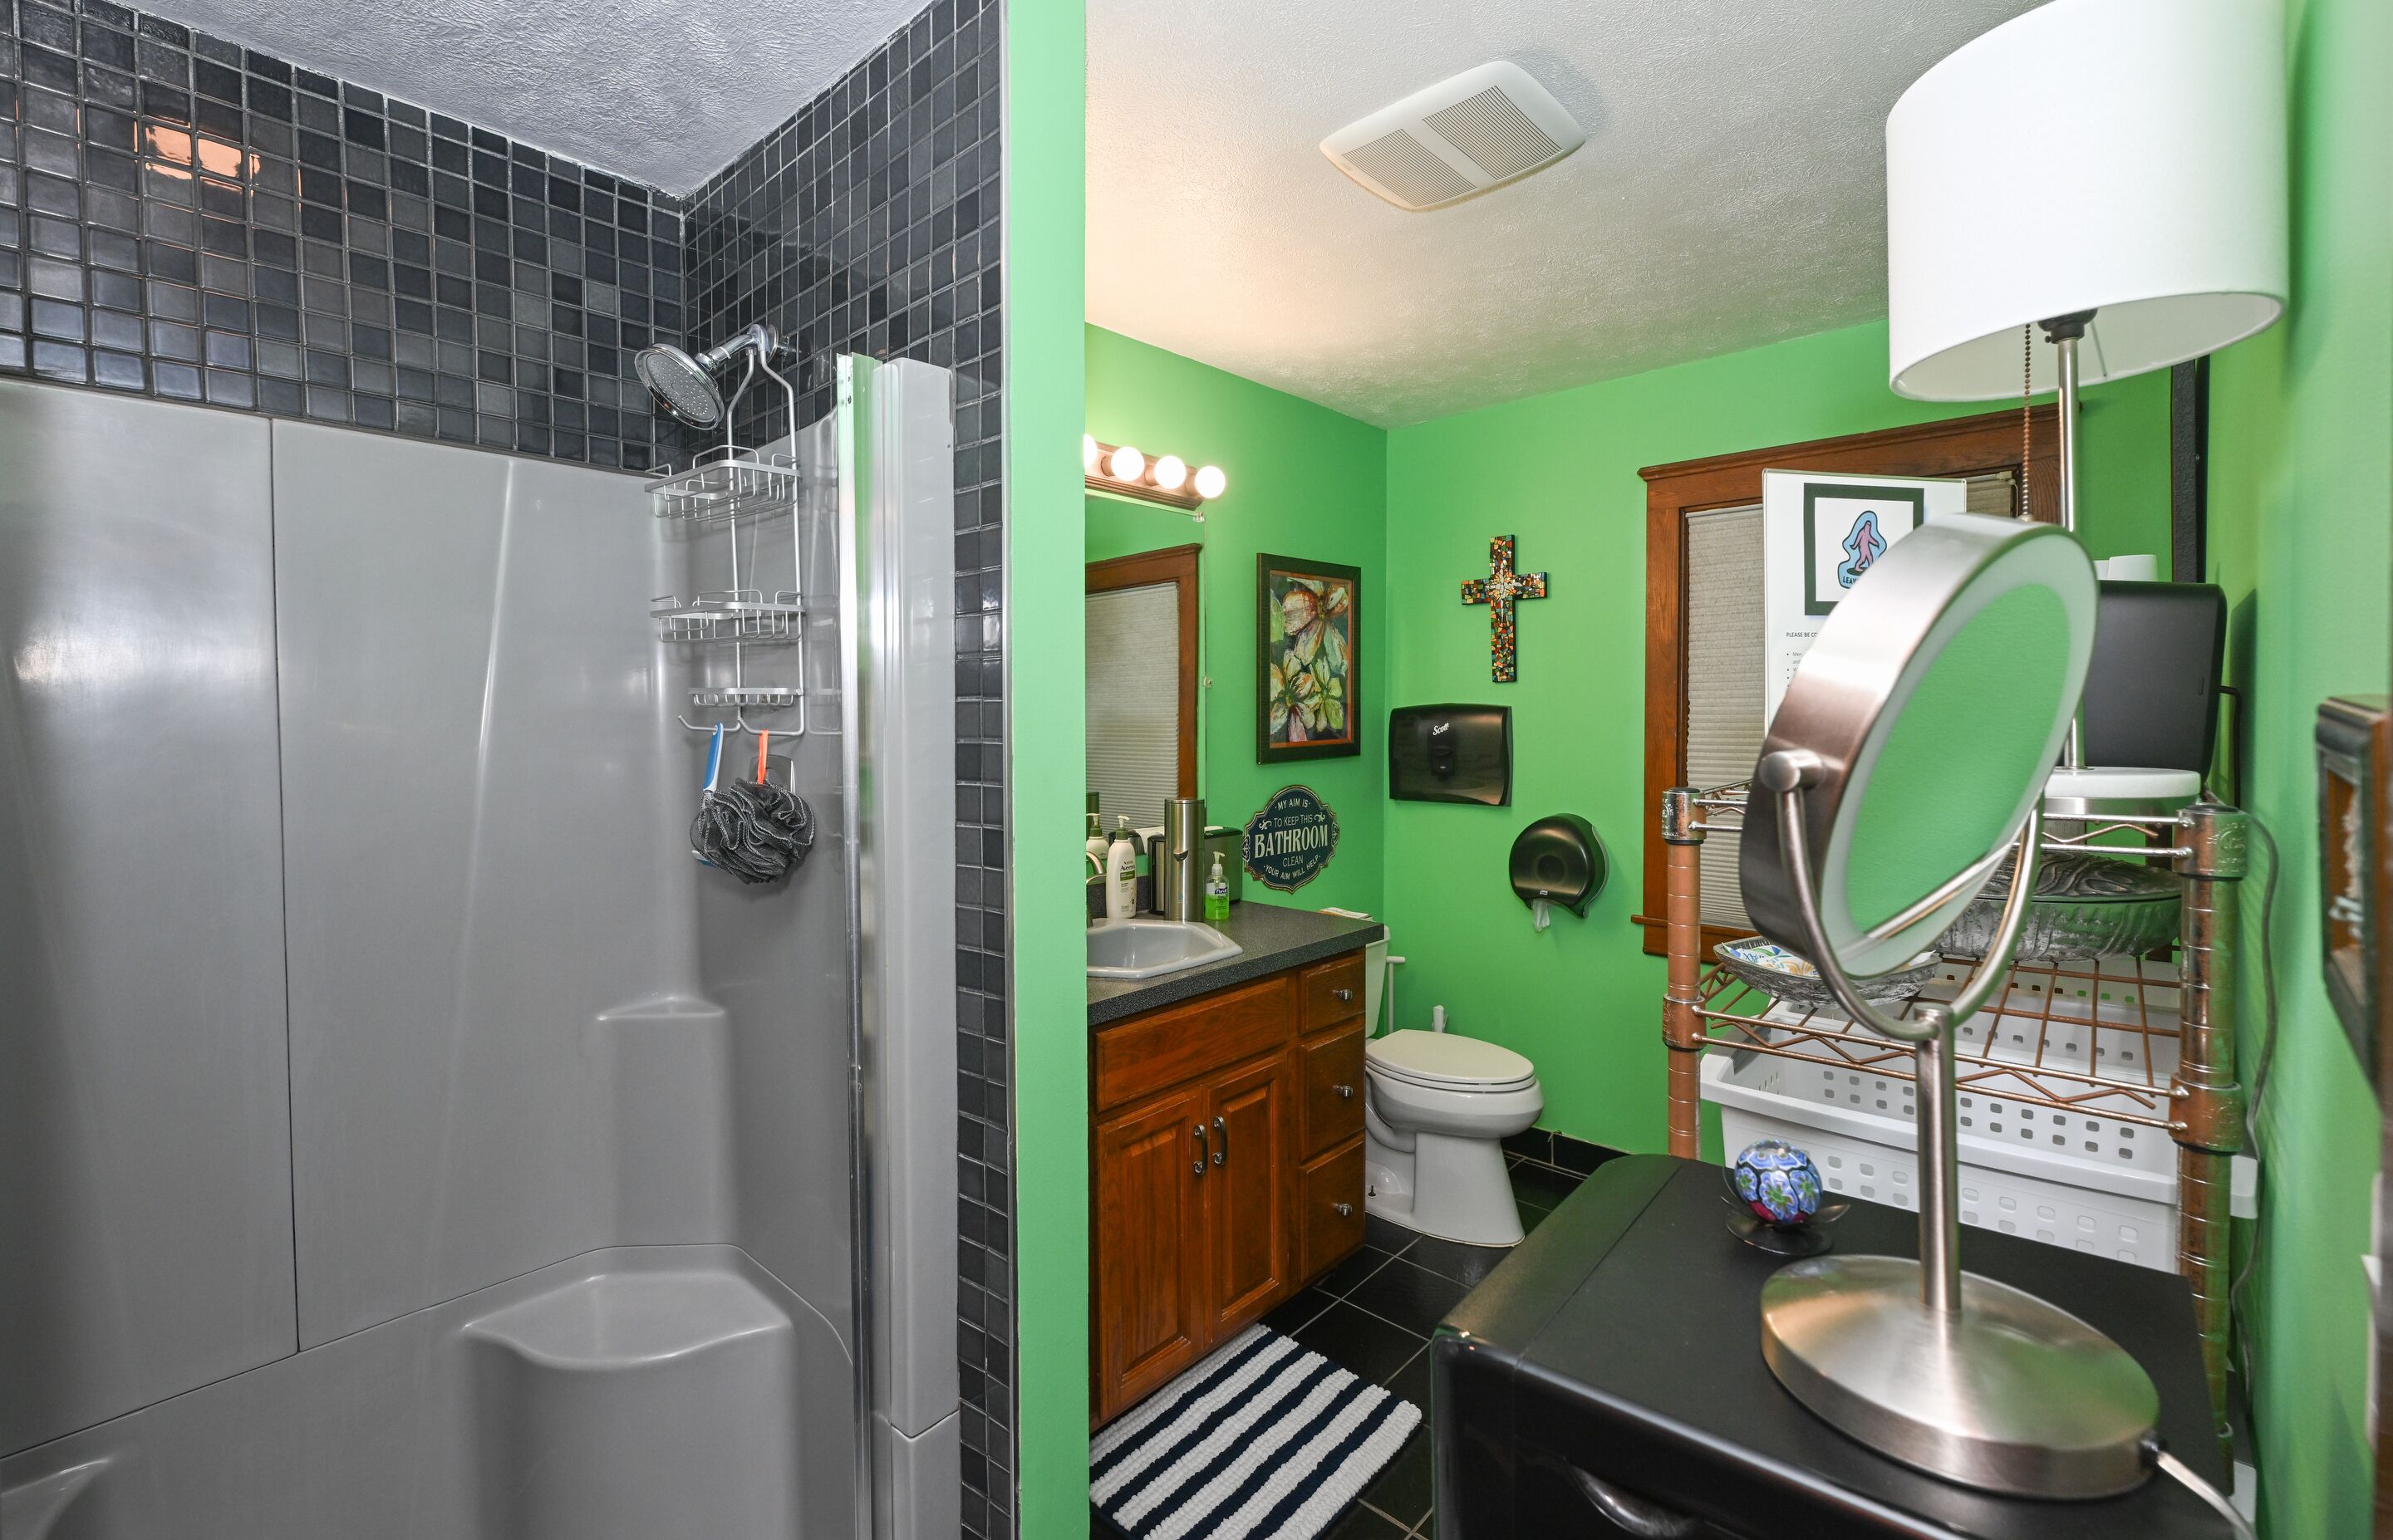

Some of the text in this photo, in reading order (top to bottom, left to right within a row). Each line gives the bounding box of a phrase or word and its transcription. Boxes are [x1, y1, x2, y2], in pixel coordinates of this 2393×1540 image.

[1432, 722, 1450, 736] Scott
[1277, 797, 1309, 811] MY AIM IS
[1273, 814, 1313, 828] TO KEEP THIS
[1254, 823, 1329, 859] BATHROOM
[1265, 854, 1319, 880] YOUR AIM WILL HELP
[1282, 854, 1304, 867] CLEAN
